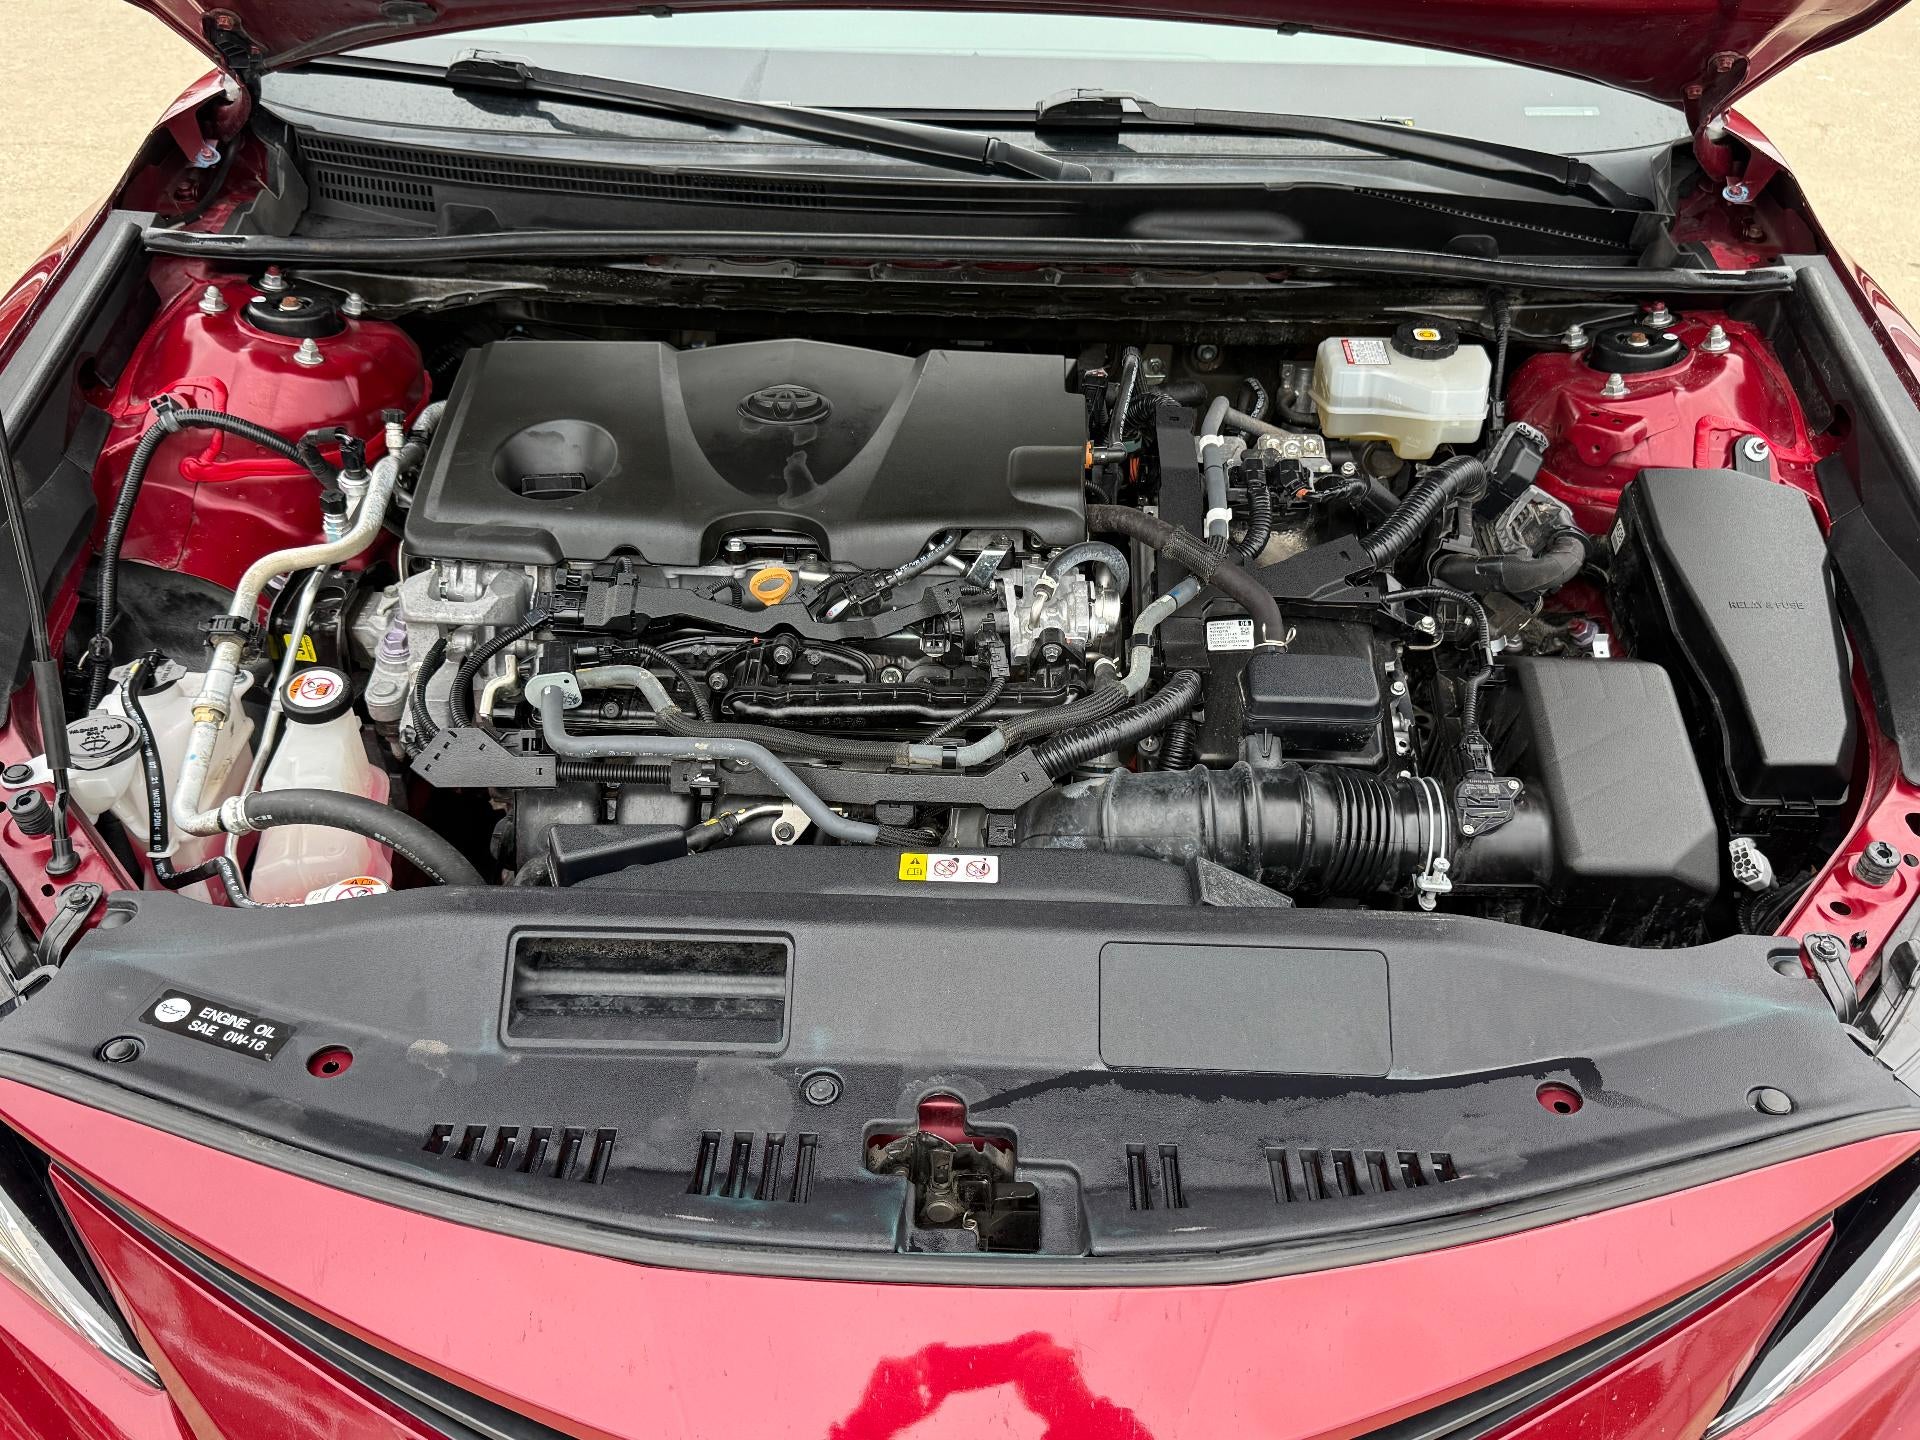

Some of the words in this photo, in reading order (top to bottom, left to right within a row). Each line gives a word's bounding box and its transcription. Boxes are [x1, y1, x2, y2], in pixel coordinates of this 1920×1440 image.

[1728, 601, 1762, 609] RELAY
[1775, 601, 1805, 610] FUSE
[187, 1020, 220, 1037] SAE
[222, 1030, 268, 1051] 0W-16
[198, 1006, 251, 1030] ENGINE
[253, 1024, 276, 1039] OIL
